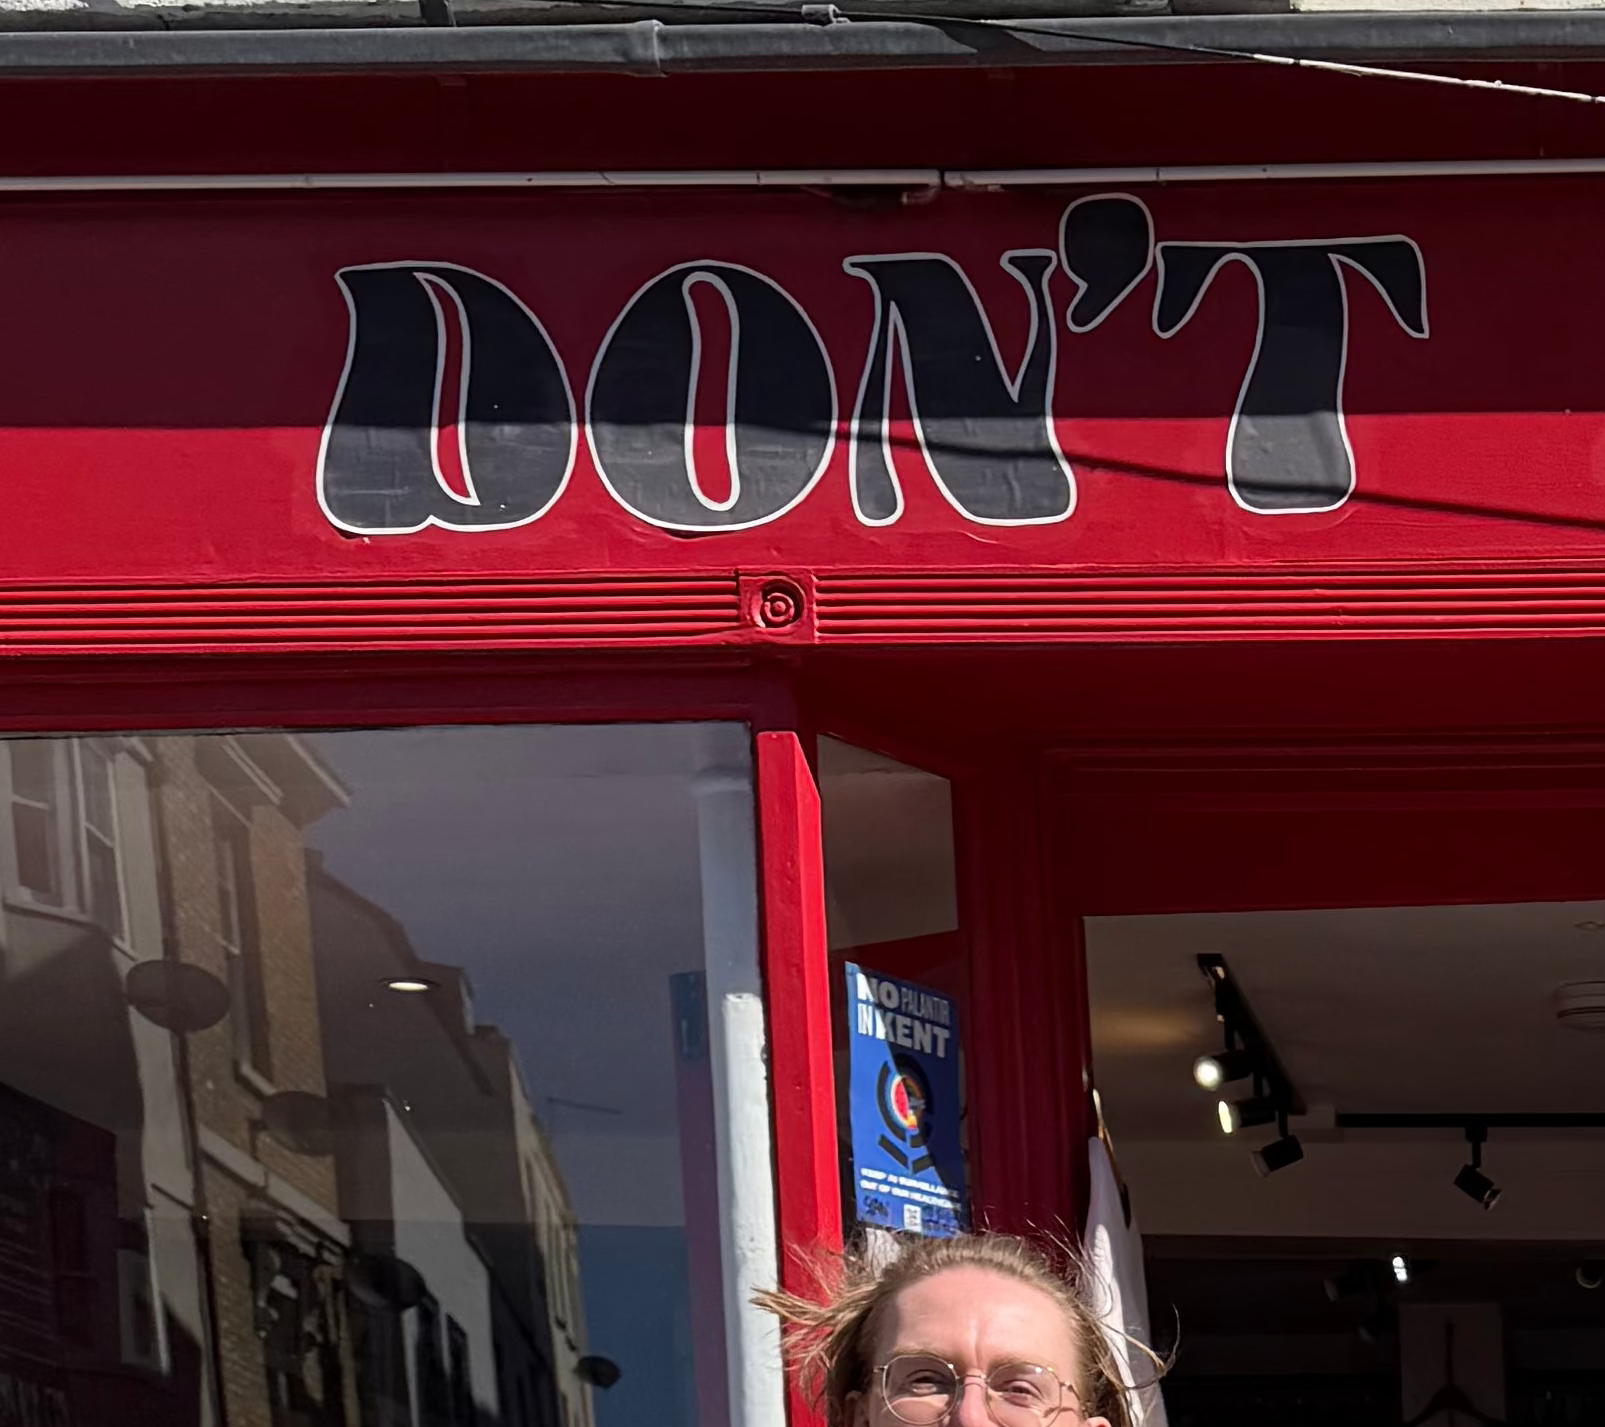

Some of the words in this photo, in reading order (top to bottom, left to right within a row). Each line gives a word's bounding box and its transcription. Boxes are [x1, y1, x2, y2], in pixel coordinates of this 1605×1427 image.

[316, 193, 1429, 535] DON'T
[856, 972, 900, 1009] NO
[874, 1008, 951, 1059] KENT
